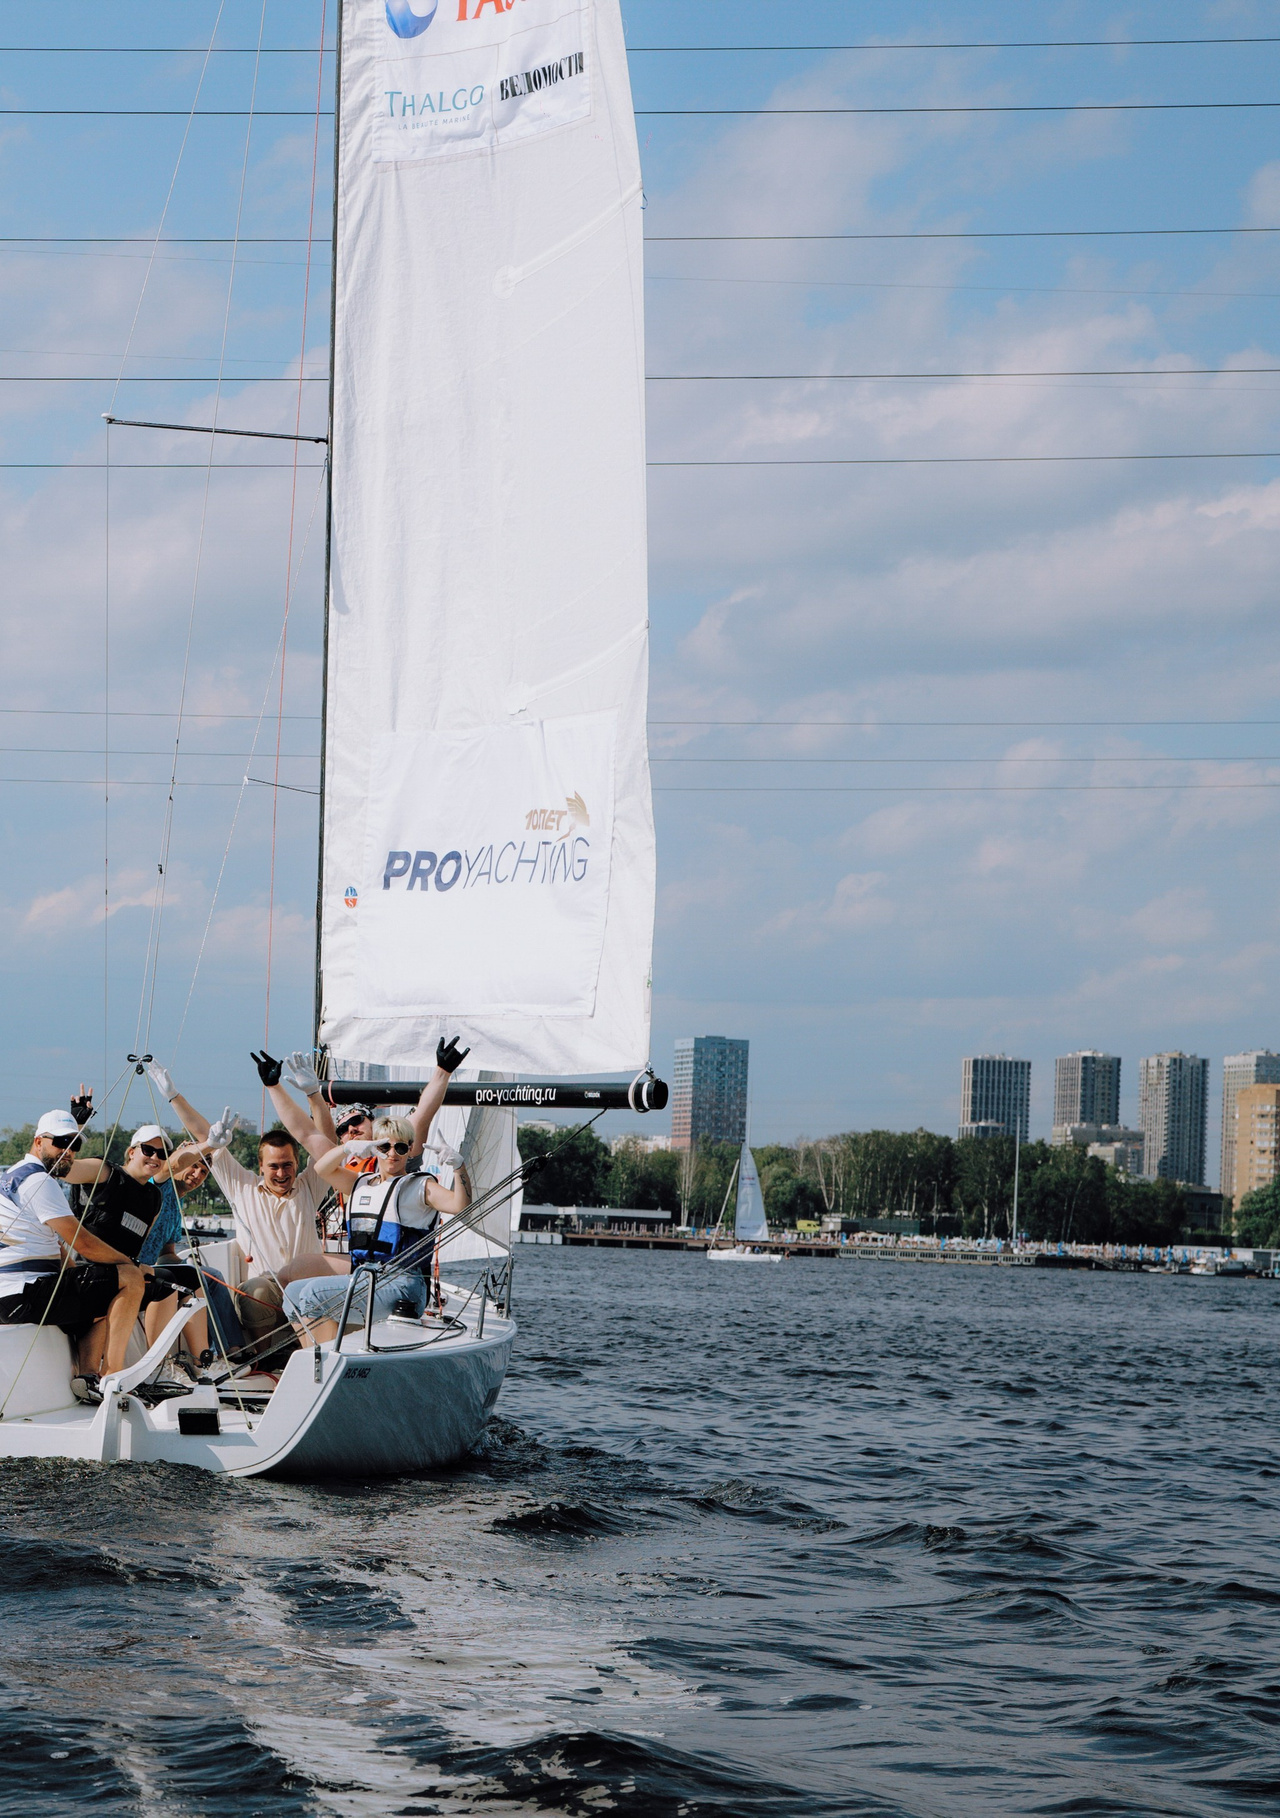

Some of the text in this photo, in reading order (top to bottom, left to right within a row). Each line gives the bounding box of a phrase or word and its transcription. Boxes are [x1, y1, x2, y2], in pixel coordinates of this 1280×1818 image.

[500, 52, 584, 101] ВЕДОМОСТИ
[384, 85, 484, 117] THALGO
[398, 123, 408, 131] LA
[442, 114, 471, 125] MARINE
[383, 837, 590, 892] PROYACHTING
[476, 1085, 557, 1105] pro-yachting.ru
